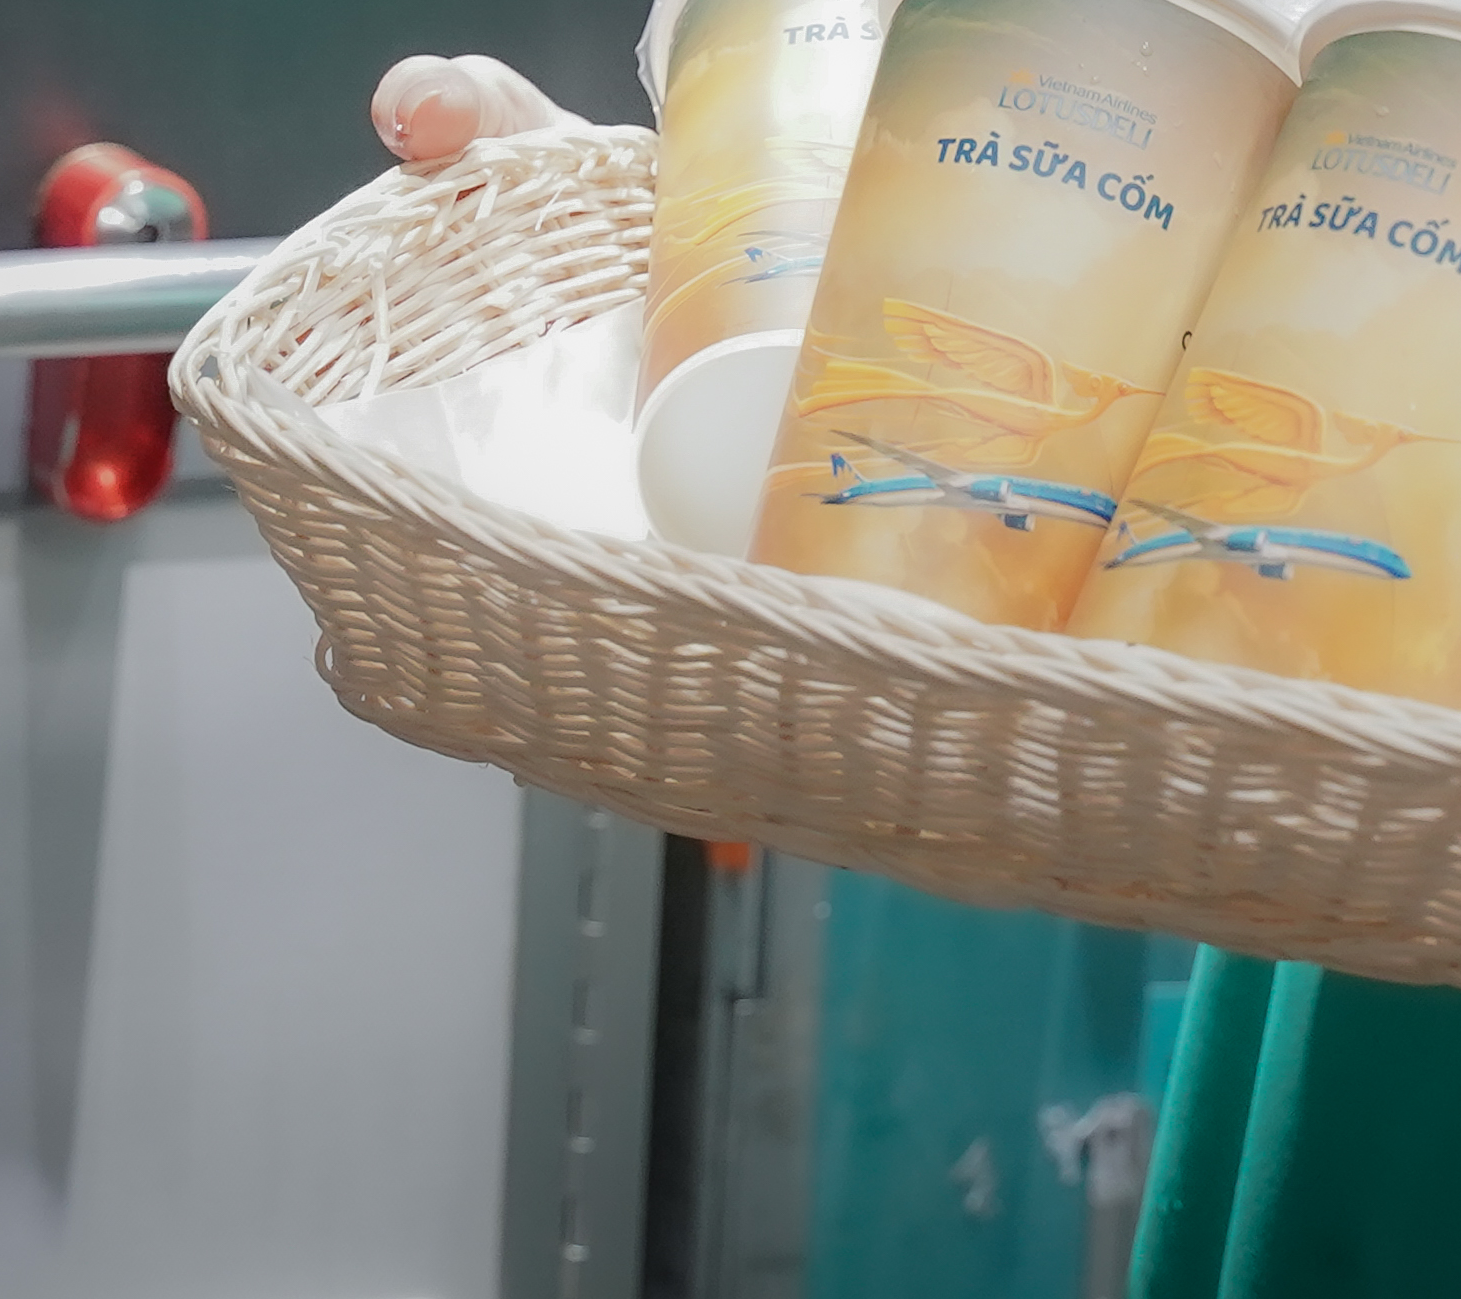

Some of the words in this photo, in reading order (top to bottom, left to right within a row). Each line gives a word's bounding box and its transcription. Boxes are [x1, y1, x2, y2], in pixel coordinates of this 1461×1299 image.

[782, 16, 850, 45] TRÀ
[997, 86, 1154, 152] LOTUSDELI
[1039, 74, 1101, 104] Vietnam
[1101, 94, 1159, 126] Airlines
[937, 130, 1001, 167] TRÀ
[1008, 140, 1087, 190] SỮA
[1096, 173, 1175, 231] CỐM
[1311, 147, 1451, 196] LOTUSDELI
[1257, 193, 1307, 233] TRÀ
[1308, 195, 1380, 239] SỮA
